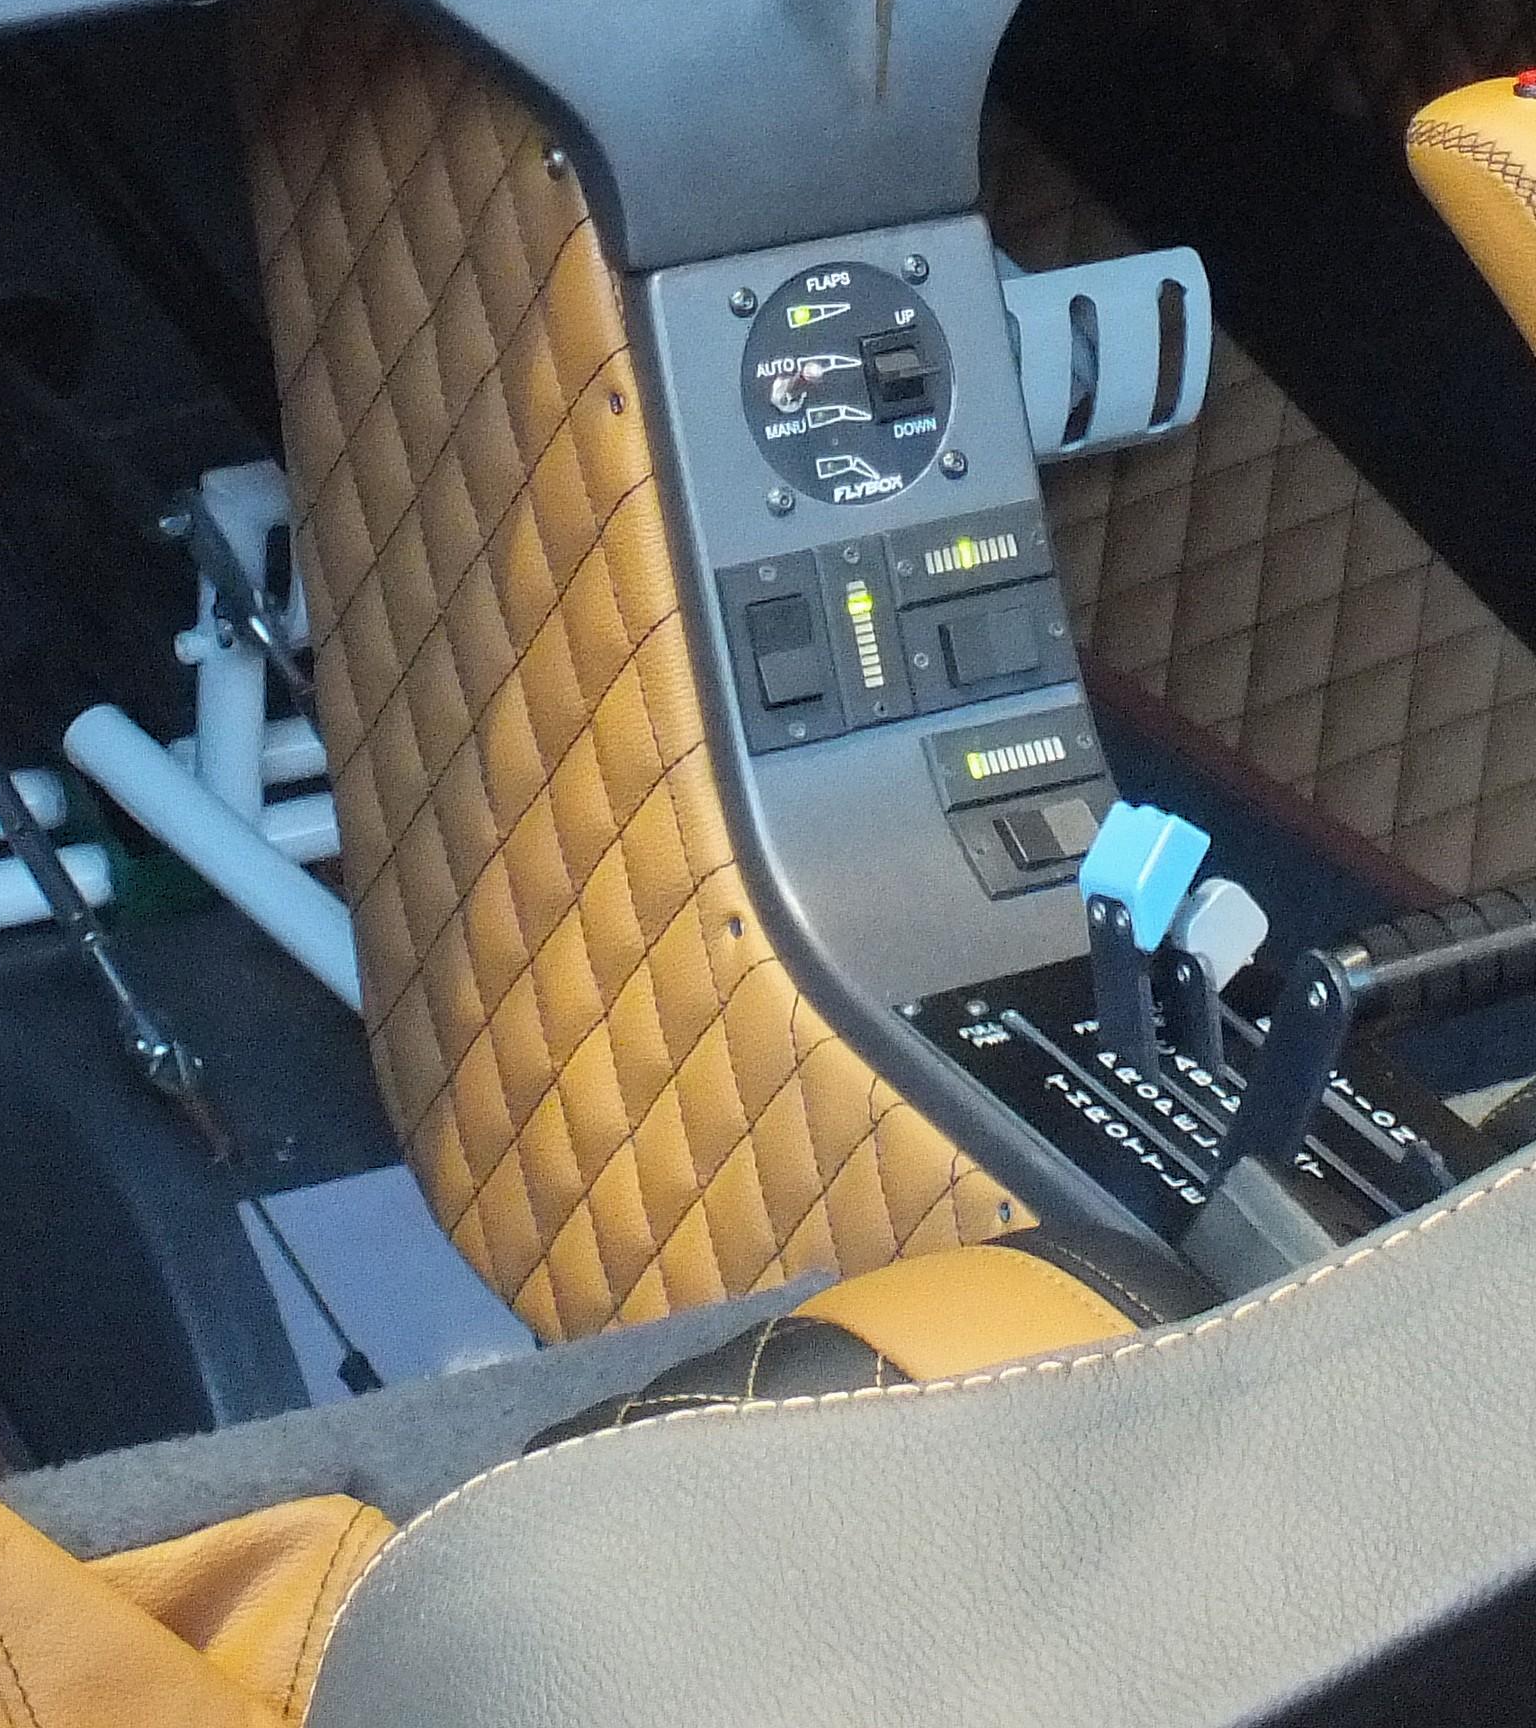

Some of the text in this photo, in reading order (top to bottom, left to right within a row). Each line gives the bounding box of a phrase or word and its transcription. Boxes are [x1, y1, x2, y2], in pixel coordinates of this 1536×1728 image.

[805, 271, 851, 293] FLAPS
[894, 307, 916, 326] UP
[756, 357, 796, 379] AUTO
[764, 421, 808, 442] MANU
[893, 415, 938, 440] DOWN
[833, 473, 905, 506] FLYBOX
[1044, 1073, 1207, 1206] THROTTLE
